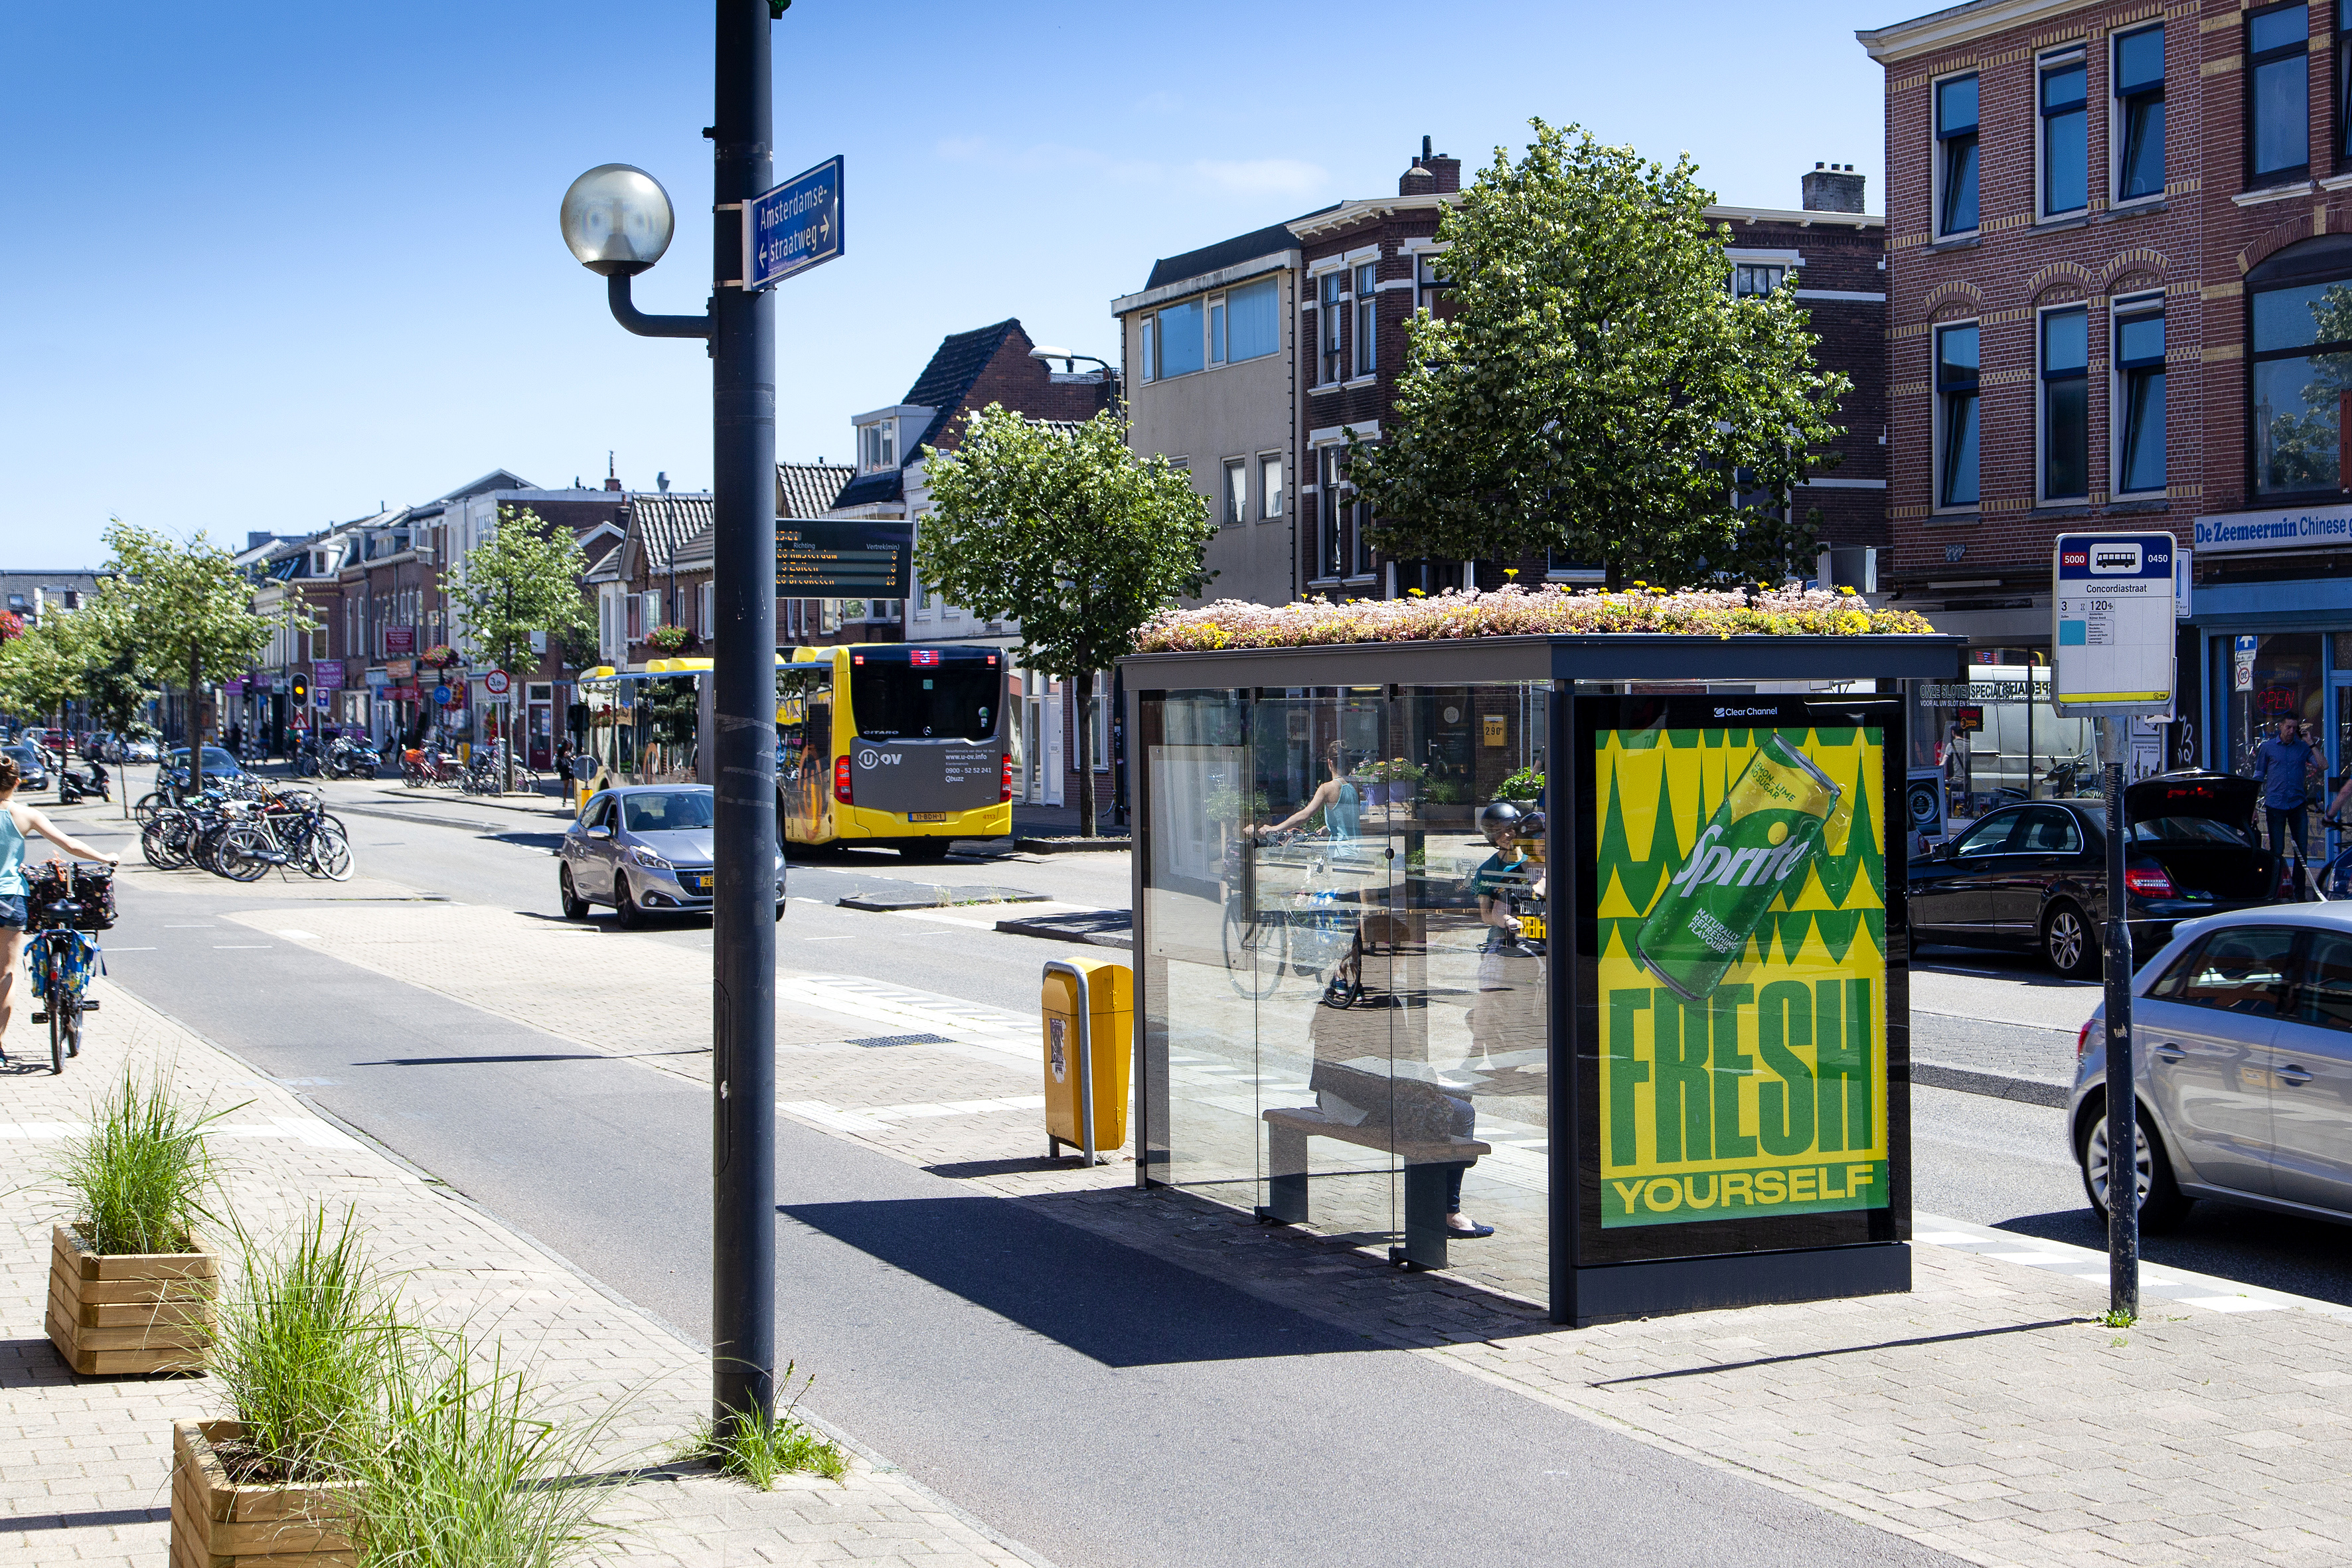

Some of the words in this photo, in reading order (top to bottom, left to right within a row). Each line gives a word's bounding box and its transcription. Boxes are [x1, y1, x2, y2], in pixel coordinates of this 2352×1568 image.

[760, 184, 827, 231] Amsterdamse-
[770, 224, 817, 262] straatweg
[2195, 523, 2212, 543] De
[2213, 518, 2297, 542] Zeemeermin
[2300, 516, 2346, 536] Chinese
[2086, 584, 2148, 593] Concordiastraat
[2061, 601, 2067, 611] 3
[2090, 601, 2108, 611] 120
[1920, 684, 1940, 698] ONZE
[2258, 691, 2295, 709] OPEN
[1959, 708, 1979, 717] Service
[1485, 726, 1500, 736] 290
[1751, 768, 1759, 777] NO
[1756, 775, 1780, 799] SUGAR
[1672, 821, 1810, 898] Sprite
[1687, 921, 1728, 954] FLAVOURS
[1691, 914, 1738, 950] REFRESHING
[1697, 907, 1741, 941] NATURALLY
[1608, 978, 1873, 1167] FRESH
[1612, 1164, 1873, 1214] YOURSELF
